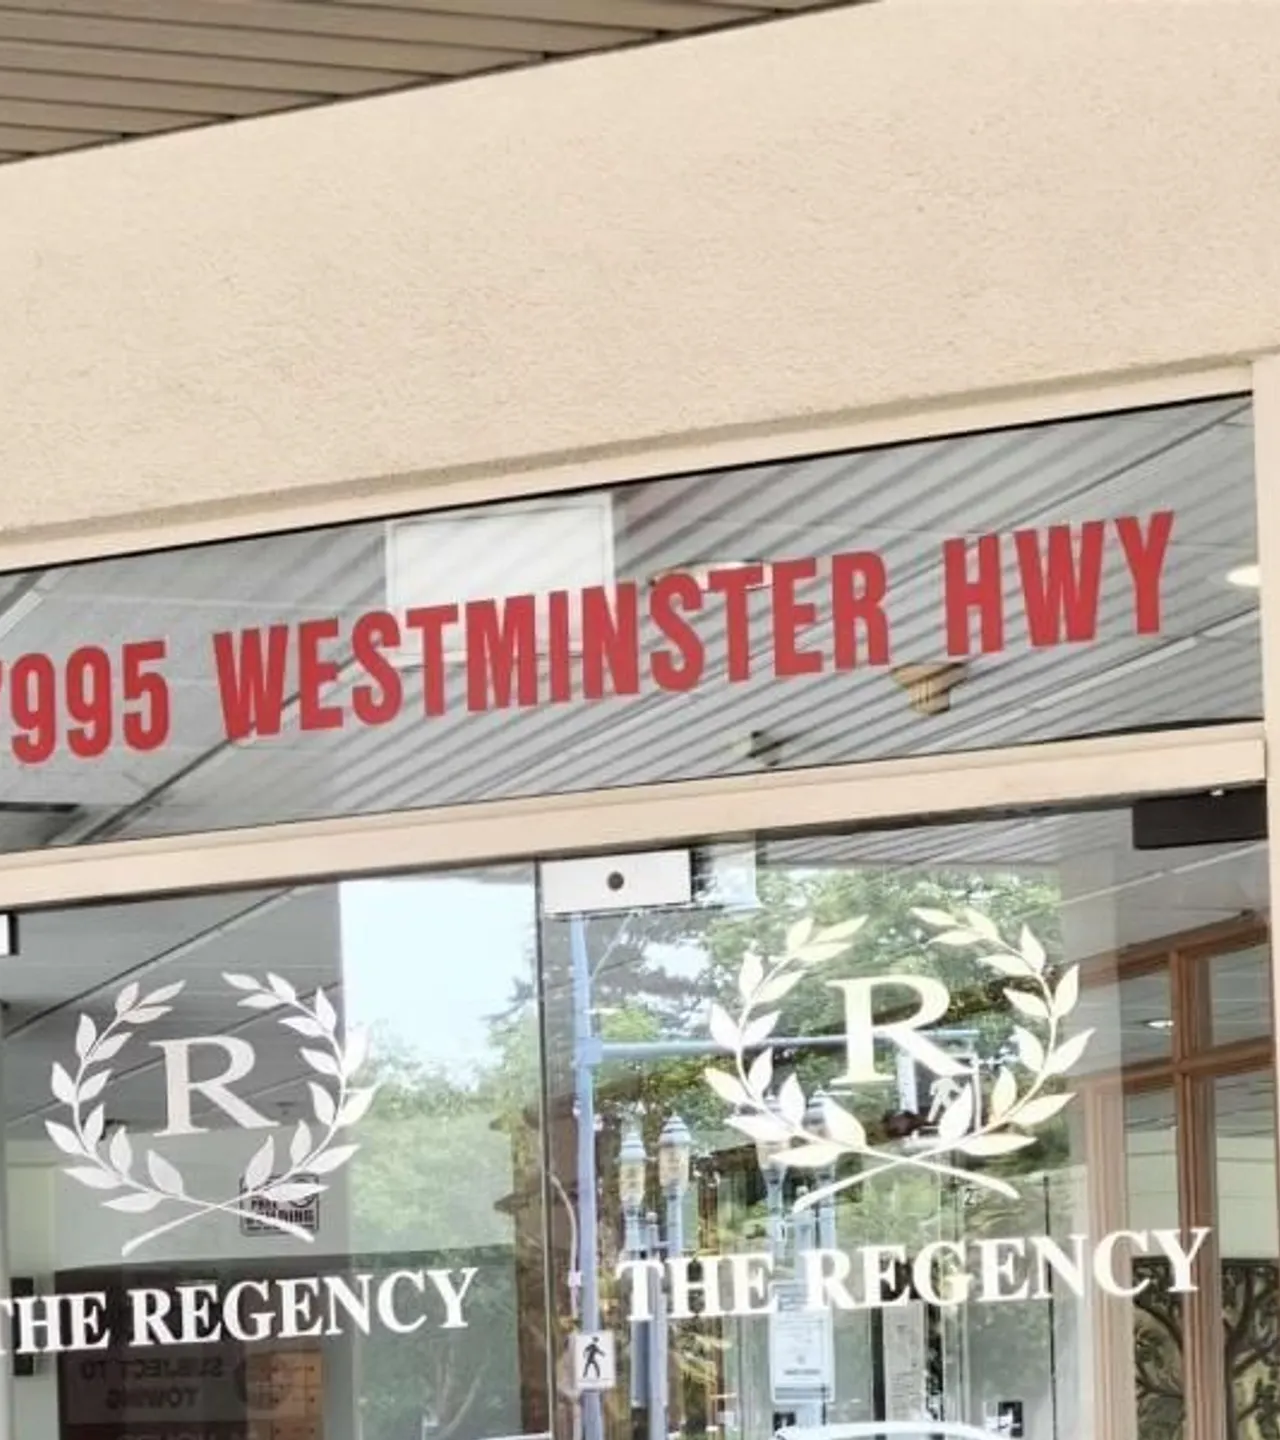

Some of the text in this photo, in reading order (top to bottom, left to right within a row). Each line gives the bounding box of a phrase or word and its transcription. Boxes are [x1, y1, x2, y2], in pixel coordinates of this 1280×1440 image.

[212, 550, 891, 742] WESTMINSTER
[943, 510, 1174, 657] HWY
[825, 974, 979, 1086] R
[149, 1035, 280, 1137] R
[128, 1266, 479, 1348] REGENCY
[615, 1226, 1211, 1323] THE REGENCY
